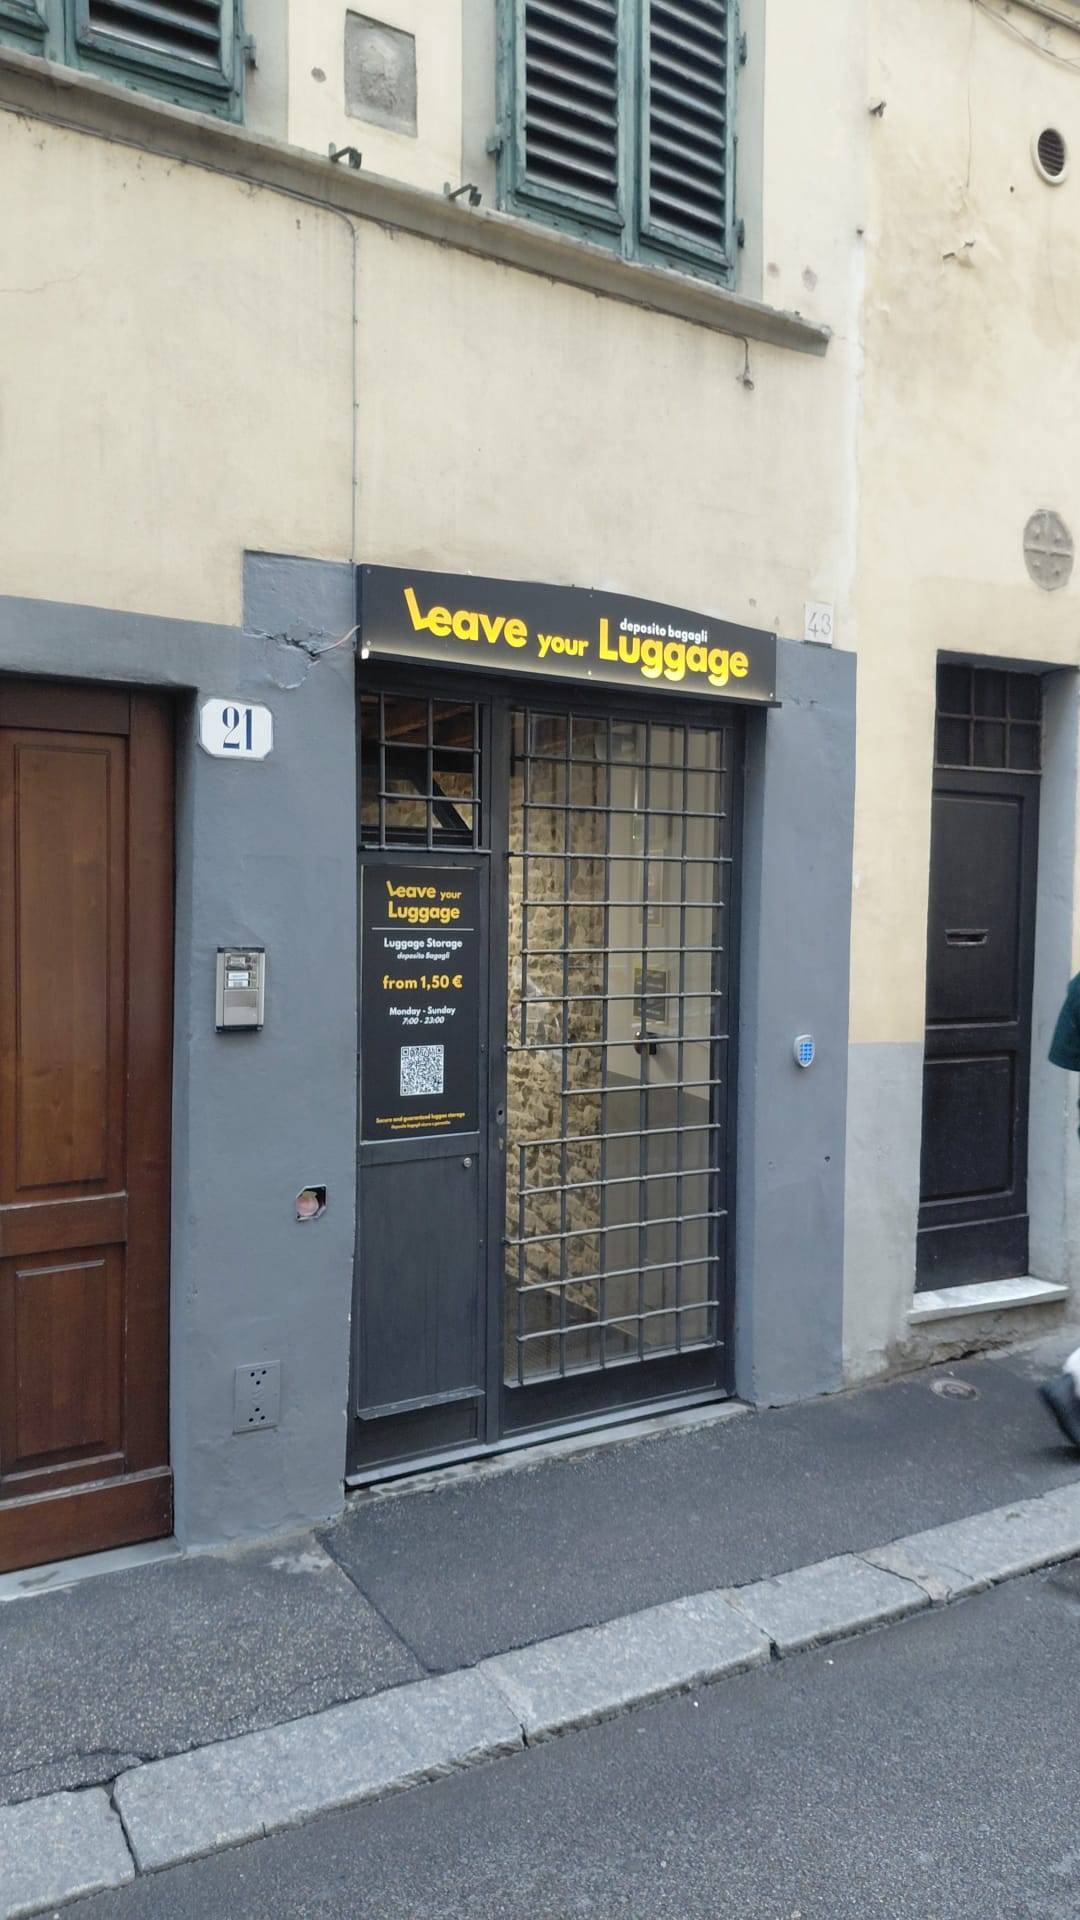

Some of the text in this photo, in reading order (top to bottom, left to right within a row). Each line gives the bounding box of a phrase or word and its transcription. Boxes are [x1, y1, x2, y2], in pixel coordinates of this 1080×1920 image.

[619, 617, 708, 644] deposito bagagli
[808, 612, 832, 638] 43
[404, 587, 749, 687] Leave your Luggage
[222, 706, 252, 751] 21
[386, 880, 462, 901] Leave your
[388, 900, 460, 923] Luggage
[384, 937, 463, 950] Luggage Storage
[383, 974, 463, 991] from 1,50 €
[389, 1006, 421, 1017] Monday
[427, 1005, 456, 1016] Sunday
[402, 1017, 419, 1025] 7:00
[424, 1016, 445, 1025] 23:00
